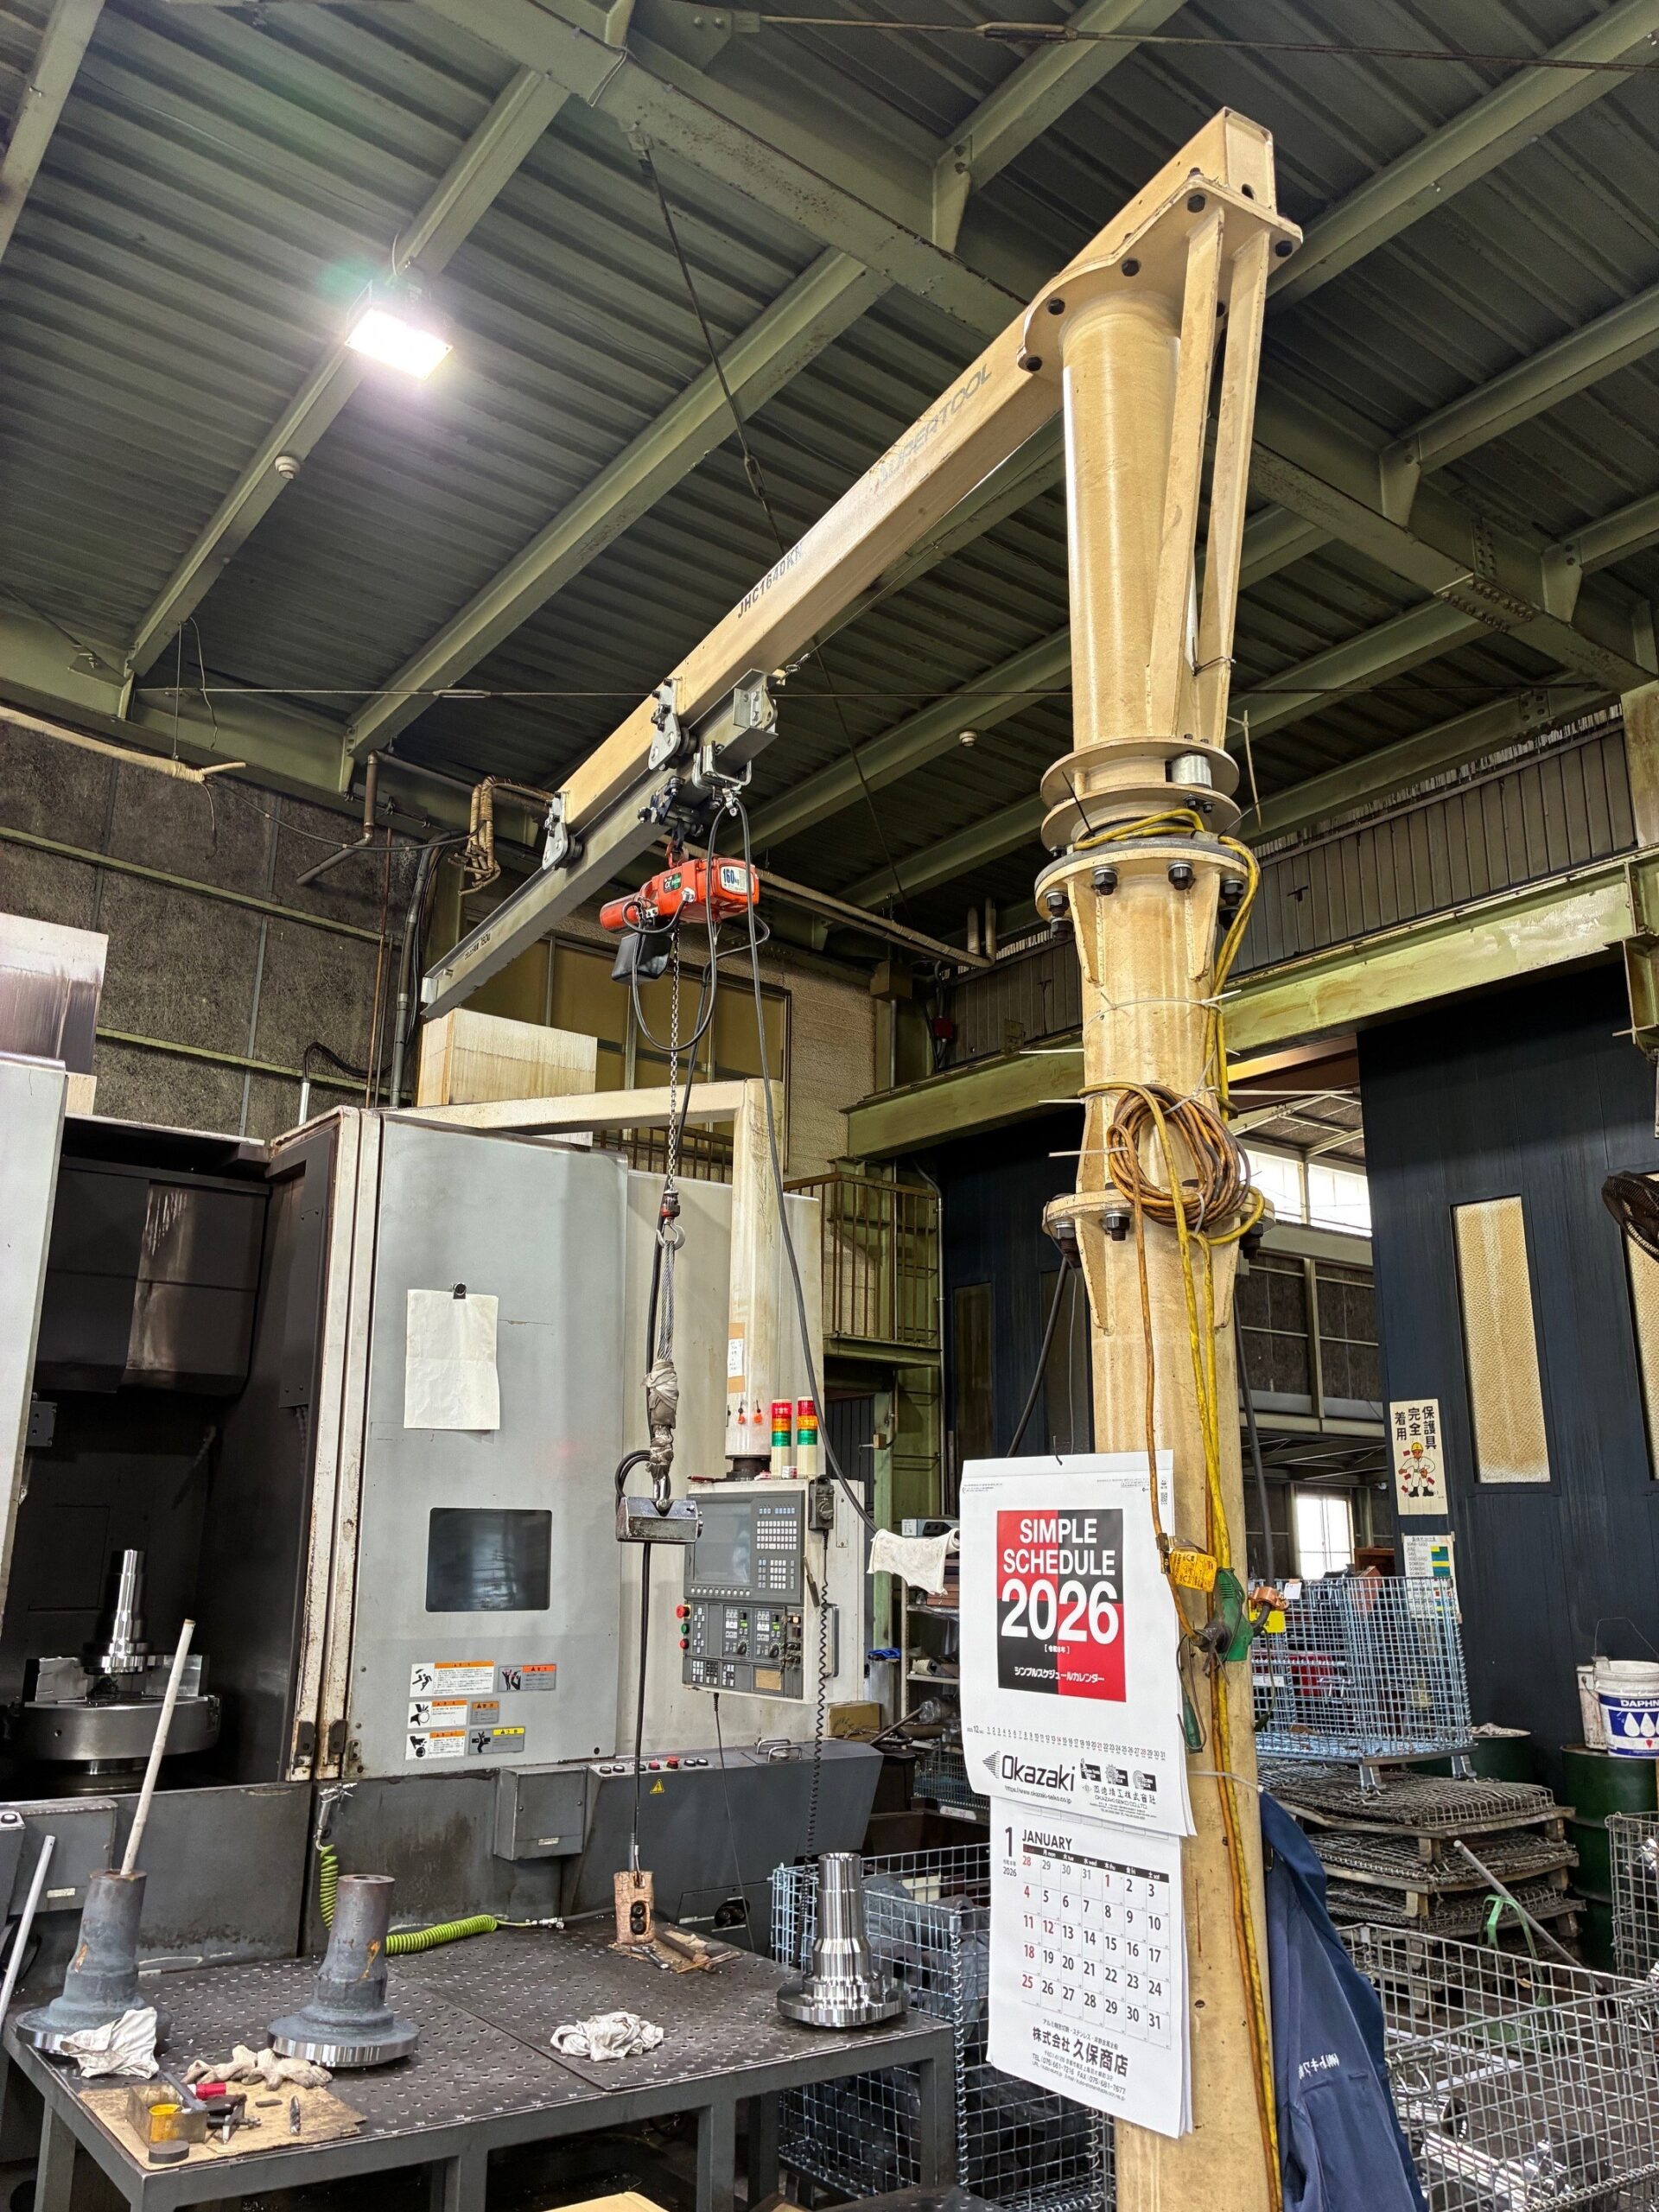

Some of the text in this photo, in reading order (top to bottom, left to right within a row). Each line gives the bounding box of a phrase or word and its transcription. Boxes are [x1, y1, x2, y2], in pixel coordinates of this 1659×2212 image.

[1395, 1411, 1407, 1441] 着用
[1408, 1408, 1421, 1436] 完全
[1422, 1406, 1437, 1450] 保護具
[1020, 1518, 1097, 1544] SIMPLE
[1003, 1548, 1116, 1576] SCHEDULE
[1001, 1578, 1118, 1644] 2026
[1014, 1666, 1105, 1683] シンプルスケジュールカレンダー
[1002, 1755, 1075, 1791] Okazaki
[1005, 1827, 1013, 1857] 1
[1022, 1829, 1072, 1851] JANUARY
[1003, 1866, 1017, 1877] 2026
[1022, 1855, 1155, 1897] 28 29 30 31 1 2 3
[1024, 1885, 1161, 1931] 4 5 6 7 8 9 10
[1023, 1915, 1161, 1963] 11 12 13 14 15 16 17
[1024, 1944, 1162, 1997] 18 19 20 21 22 23 24
[1021, 1974, 1160, 2030] 25 26 27 28 29 30 31
[1032, 2026, 1128, 2077] 株式会社 久保商店
[1032, 2053, 1040, 2063] TEL
[1077, 2069, 1086, 2080] FAX
